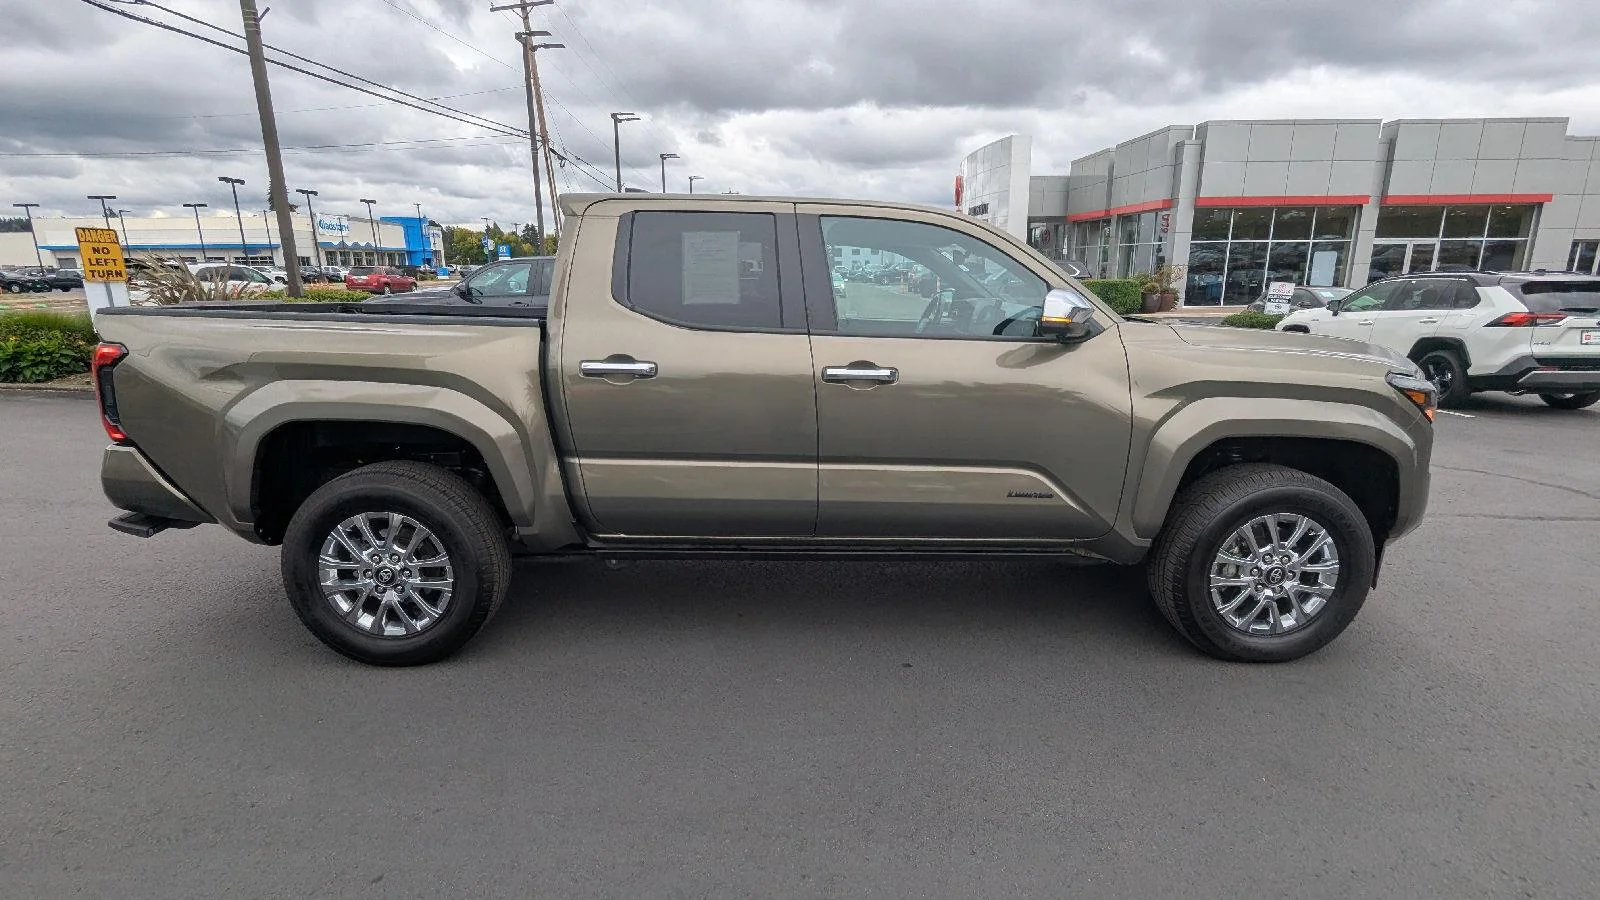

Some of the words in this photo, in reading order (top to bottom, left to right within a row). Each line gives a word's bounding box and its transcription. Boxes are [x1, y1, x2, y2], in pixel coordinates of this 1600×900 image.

[77, 229, 119, 243] DANGER
[92, 247, 111, 255] NO
[88, 258, 118, 267] LEFT
[89, 270, 123, 279] TURN
